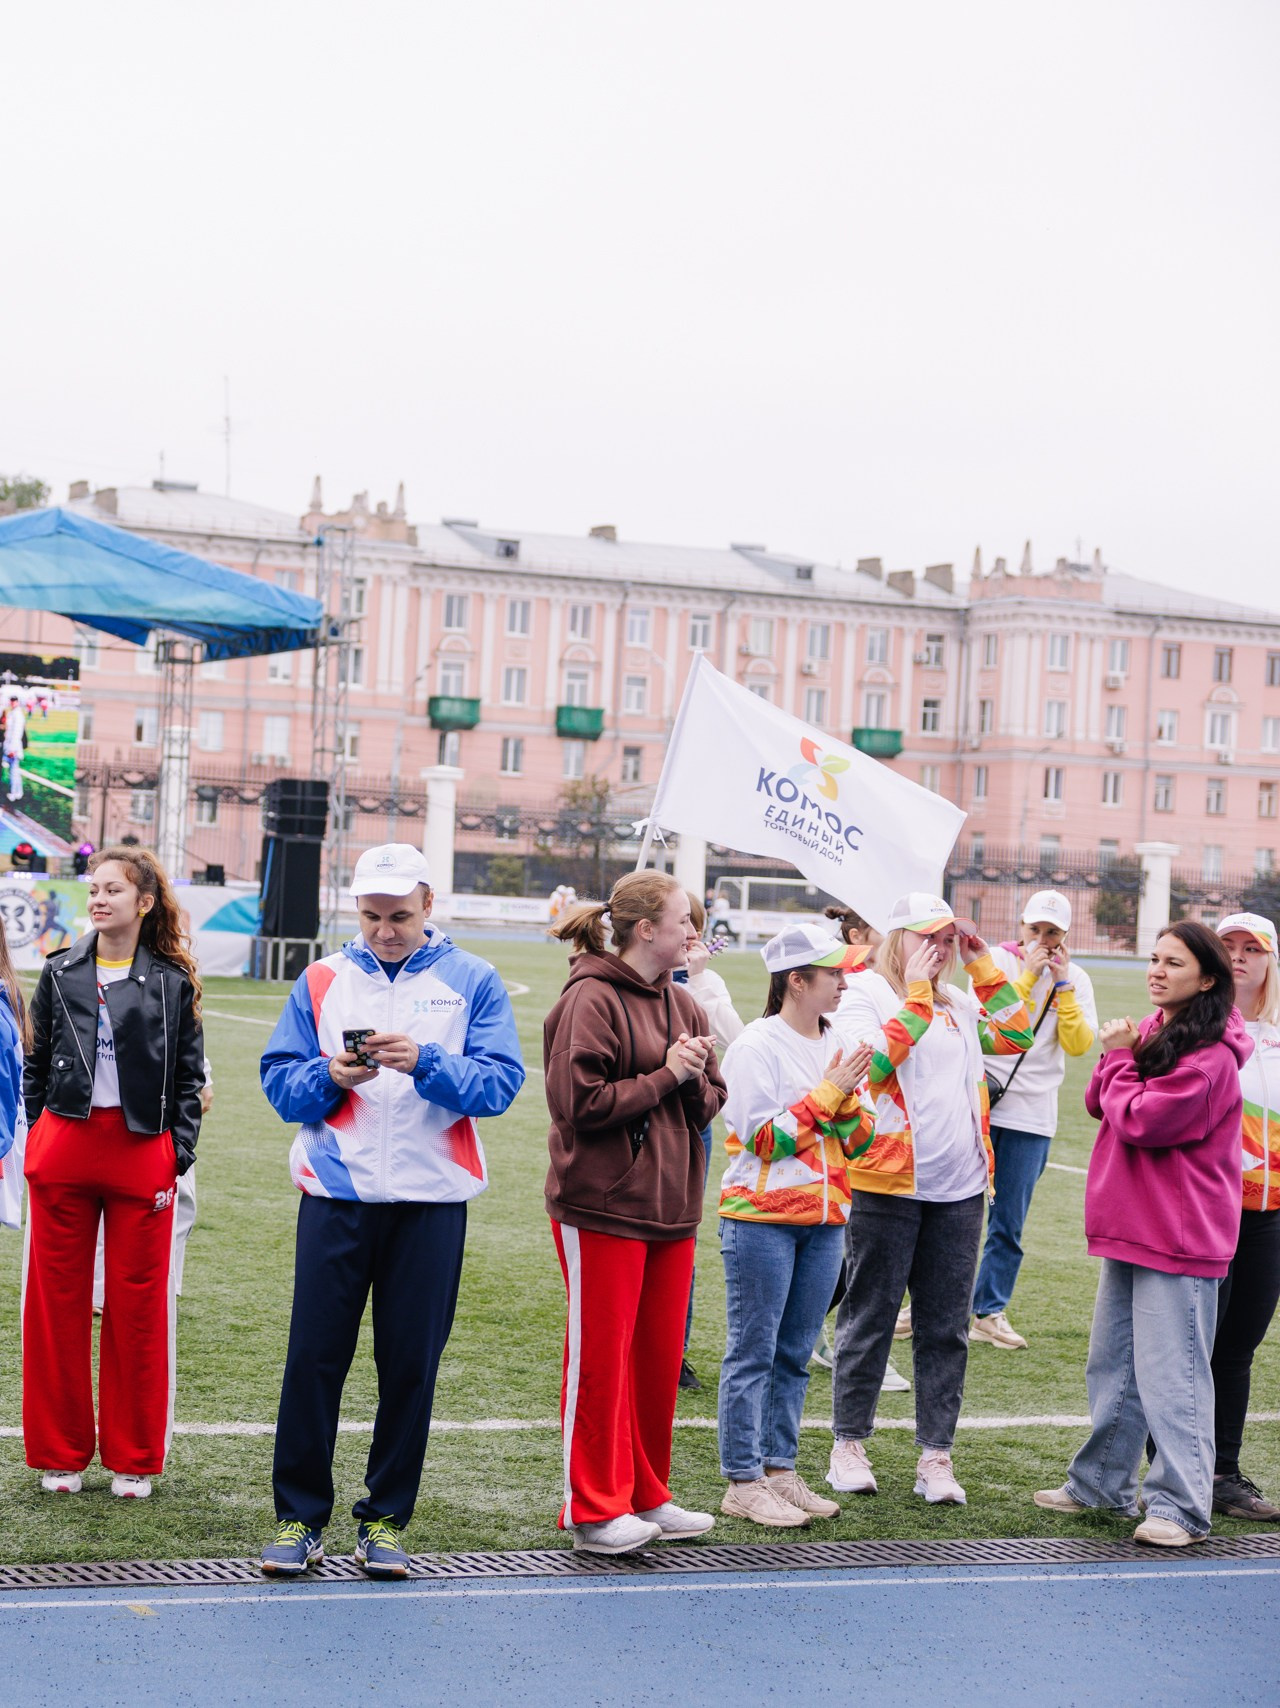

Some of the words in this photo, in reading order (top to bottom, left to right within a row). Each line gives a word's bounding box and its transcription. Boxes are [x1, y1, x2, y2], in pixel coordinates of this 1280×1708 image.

[756, 766, 864, 851] КОМОС
[764, 804, 845, 855] ЕДИНЫЙ
[763, 819, 819, 851] ТОРГОВЫЙ
[819, 846, 843, 866] ДОМ
